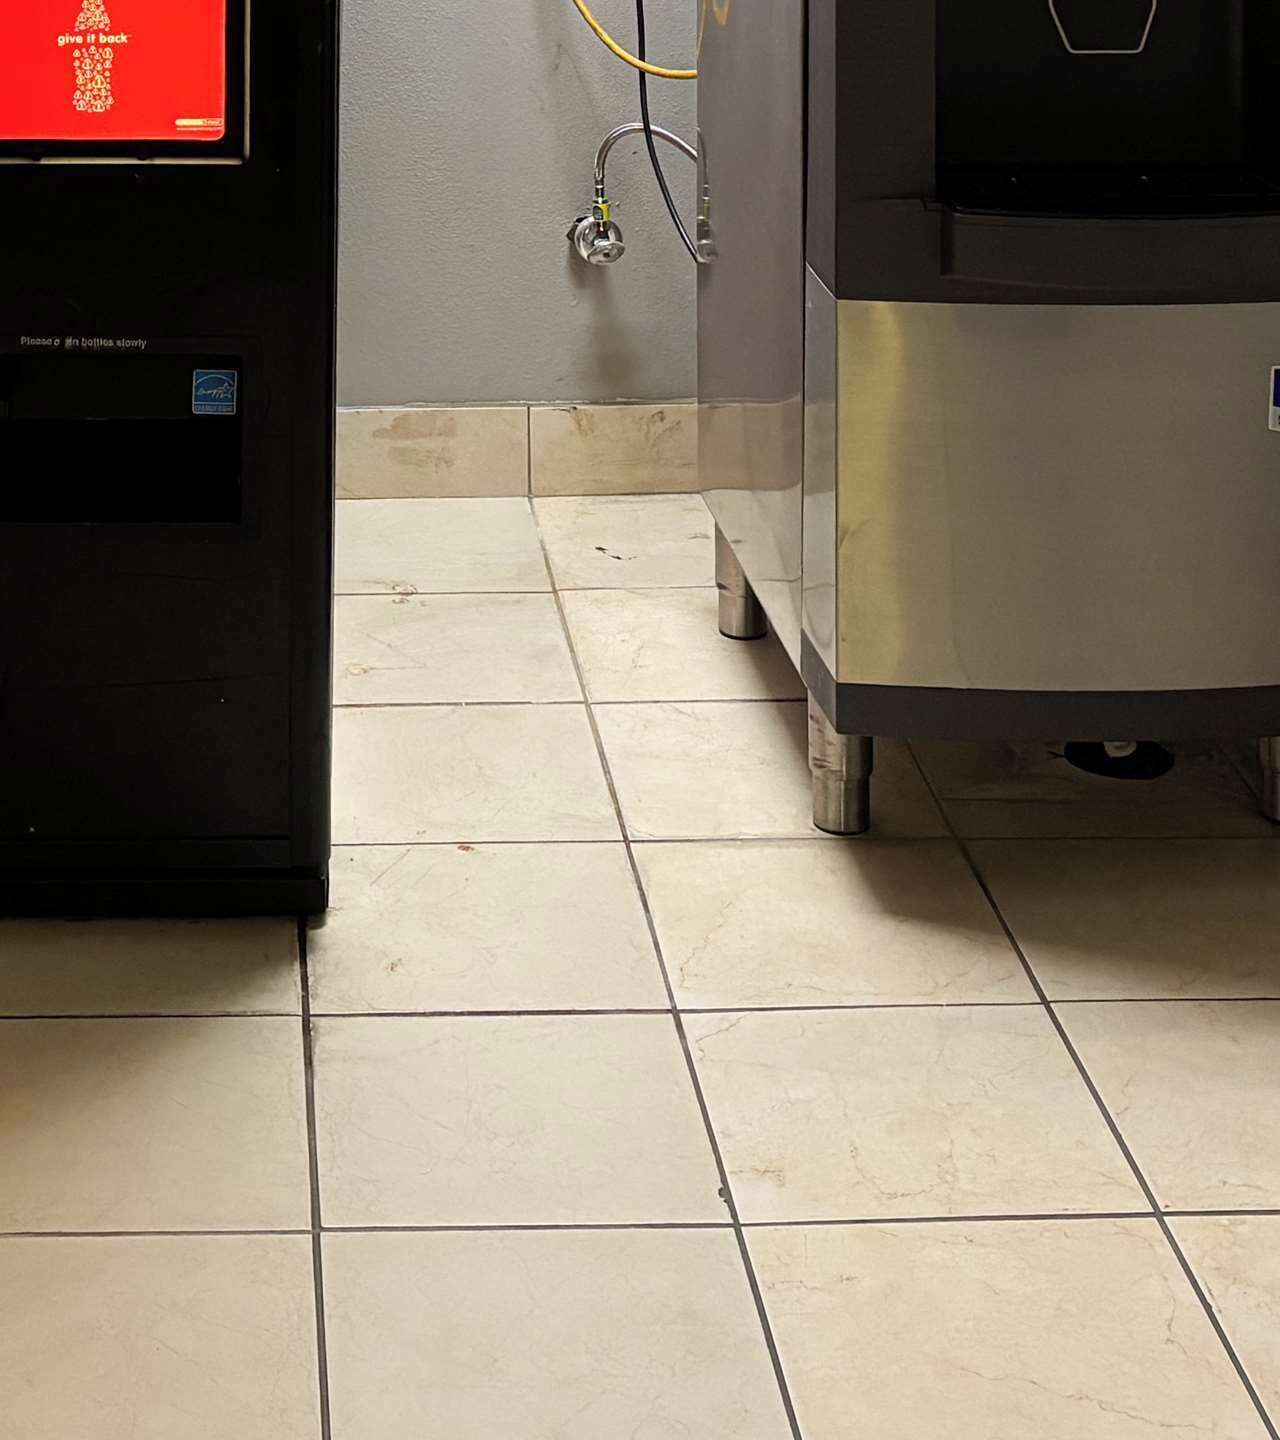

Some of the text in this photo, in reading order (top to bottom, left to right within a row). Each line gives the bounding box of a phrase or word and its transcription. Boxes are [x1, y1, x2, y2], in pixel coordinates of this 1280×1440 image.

[57, 33, 128, 46] give it back
[20, 336, 52, 346] Please
